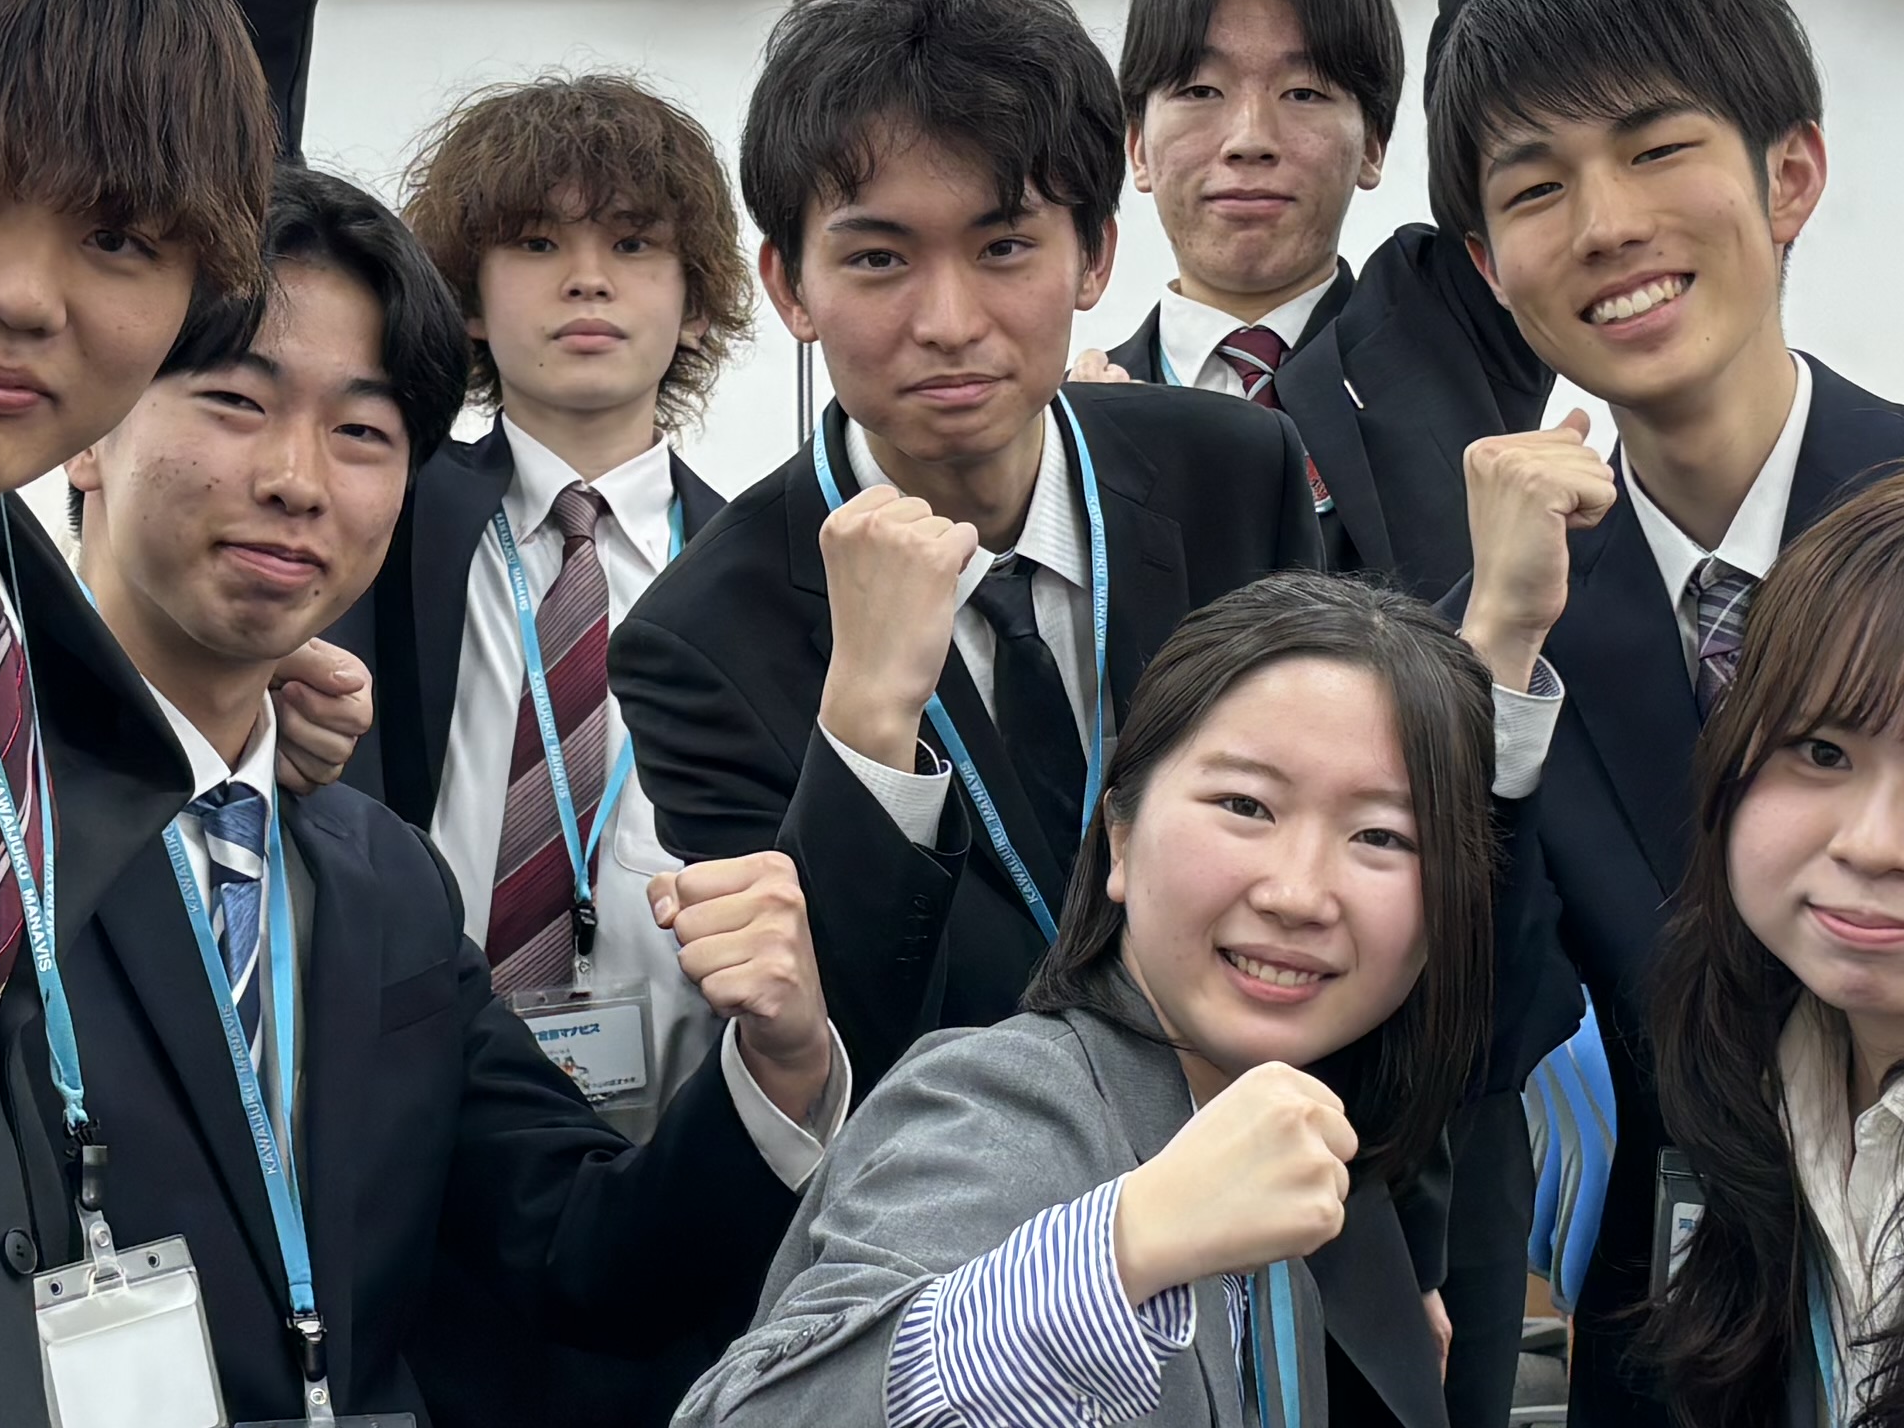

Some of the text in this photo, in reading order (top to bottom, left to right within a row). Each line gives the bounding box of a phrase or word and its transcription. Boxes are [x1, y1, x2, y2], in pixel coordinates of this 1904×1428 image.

[959, 760, 1039, 904] KAWAIJUKU MANAVIS
[22, 888, 53, 972] MANAVIS
[221, 1003, 277, 1174] KAWAIJUKU MANAVIS
